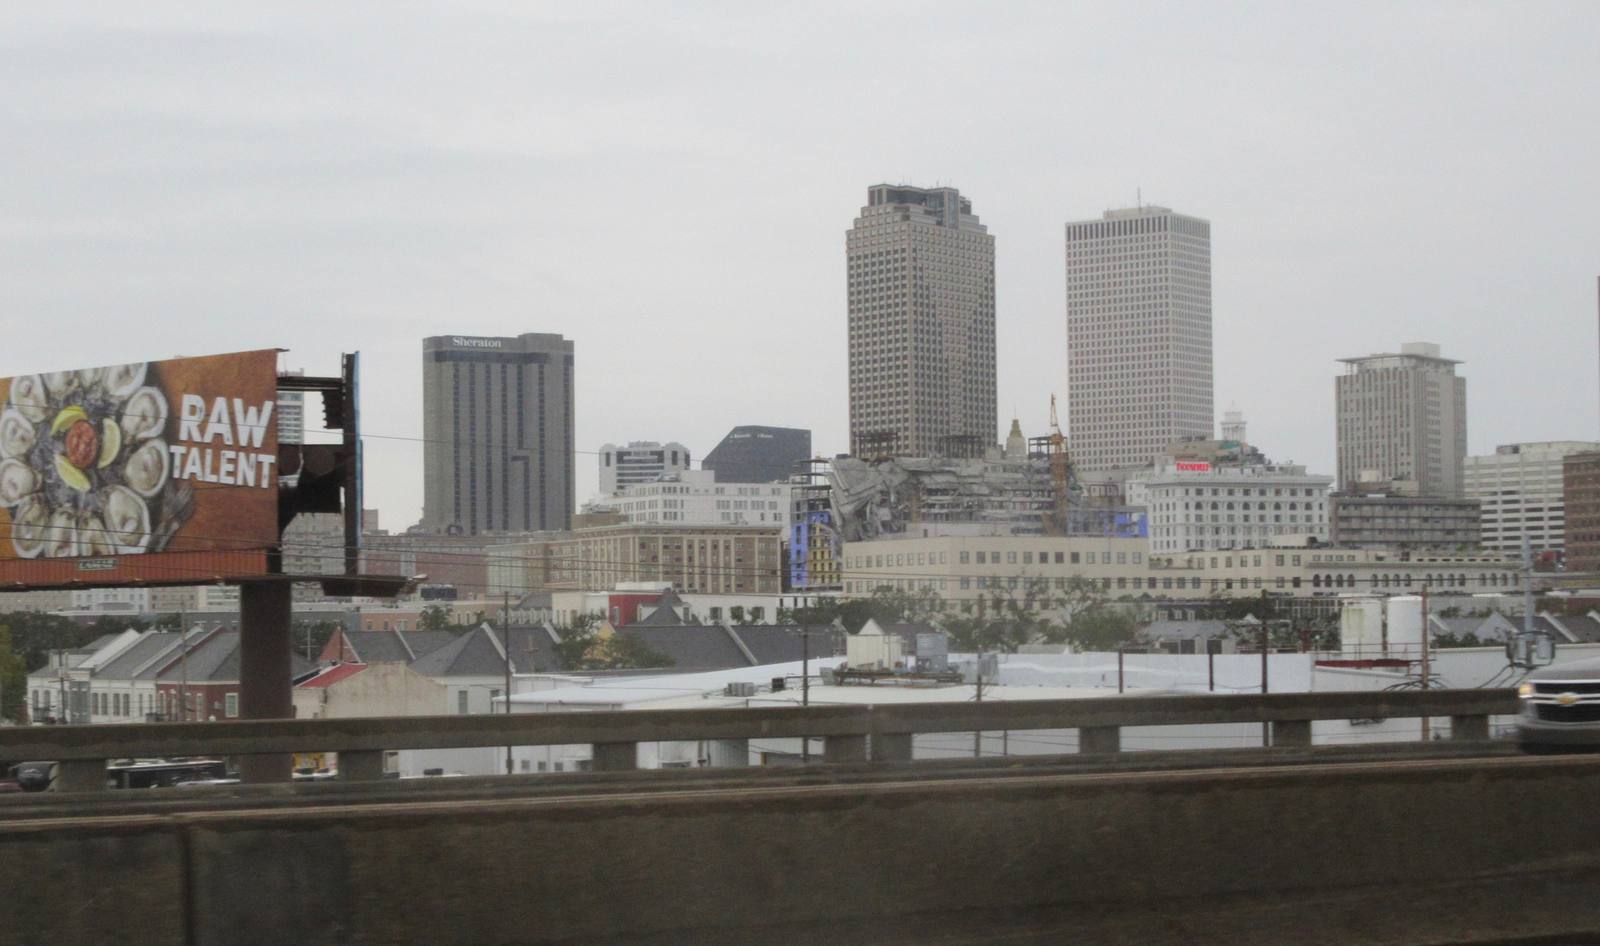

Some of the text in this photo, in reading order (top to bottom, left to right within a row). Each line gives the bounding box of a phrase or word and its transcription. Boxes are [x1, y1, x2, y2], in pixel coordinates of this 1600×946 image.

[452, 336, 502, 348] Sheraton
[179, 394, 274, 448] RAW
[169, 445, 276, 489] TALENT
